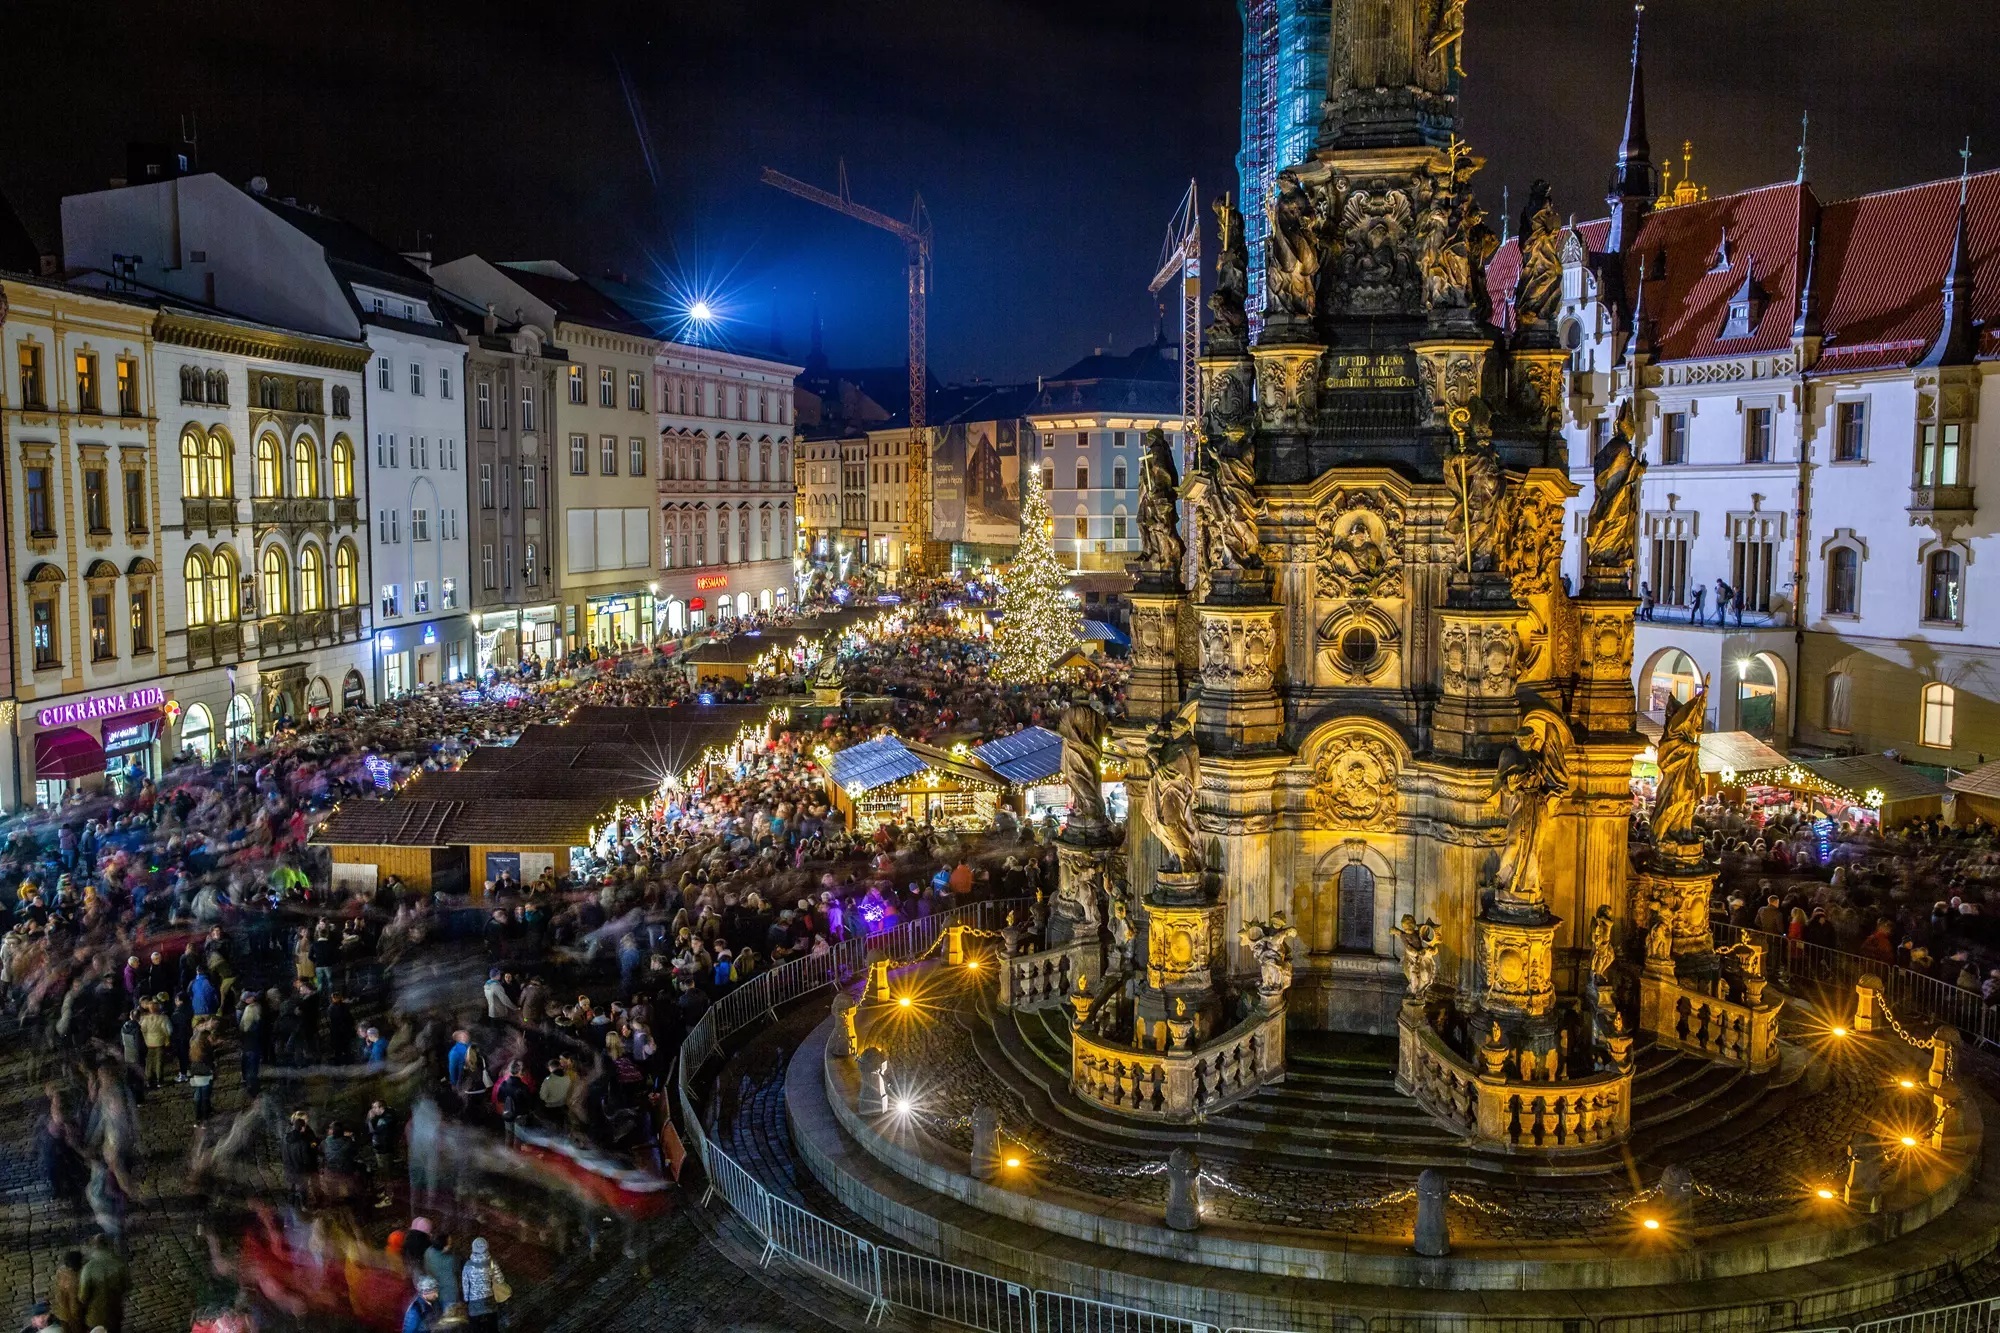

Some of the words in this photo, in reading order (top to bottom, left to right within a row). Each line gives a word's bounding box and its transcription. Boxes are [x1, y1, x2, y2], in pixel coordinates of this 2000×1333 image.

[1346, 367, 1363, 377] SPE
[697, 576, 728, 590] ROSSMANN
[42, 695, 127, 726] CUKRÁRNA
[131, 687, 165, 709] AIDA
